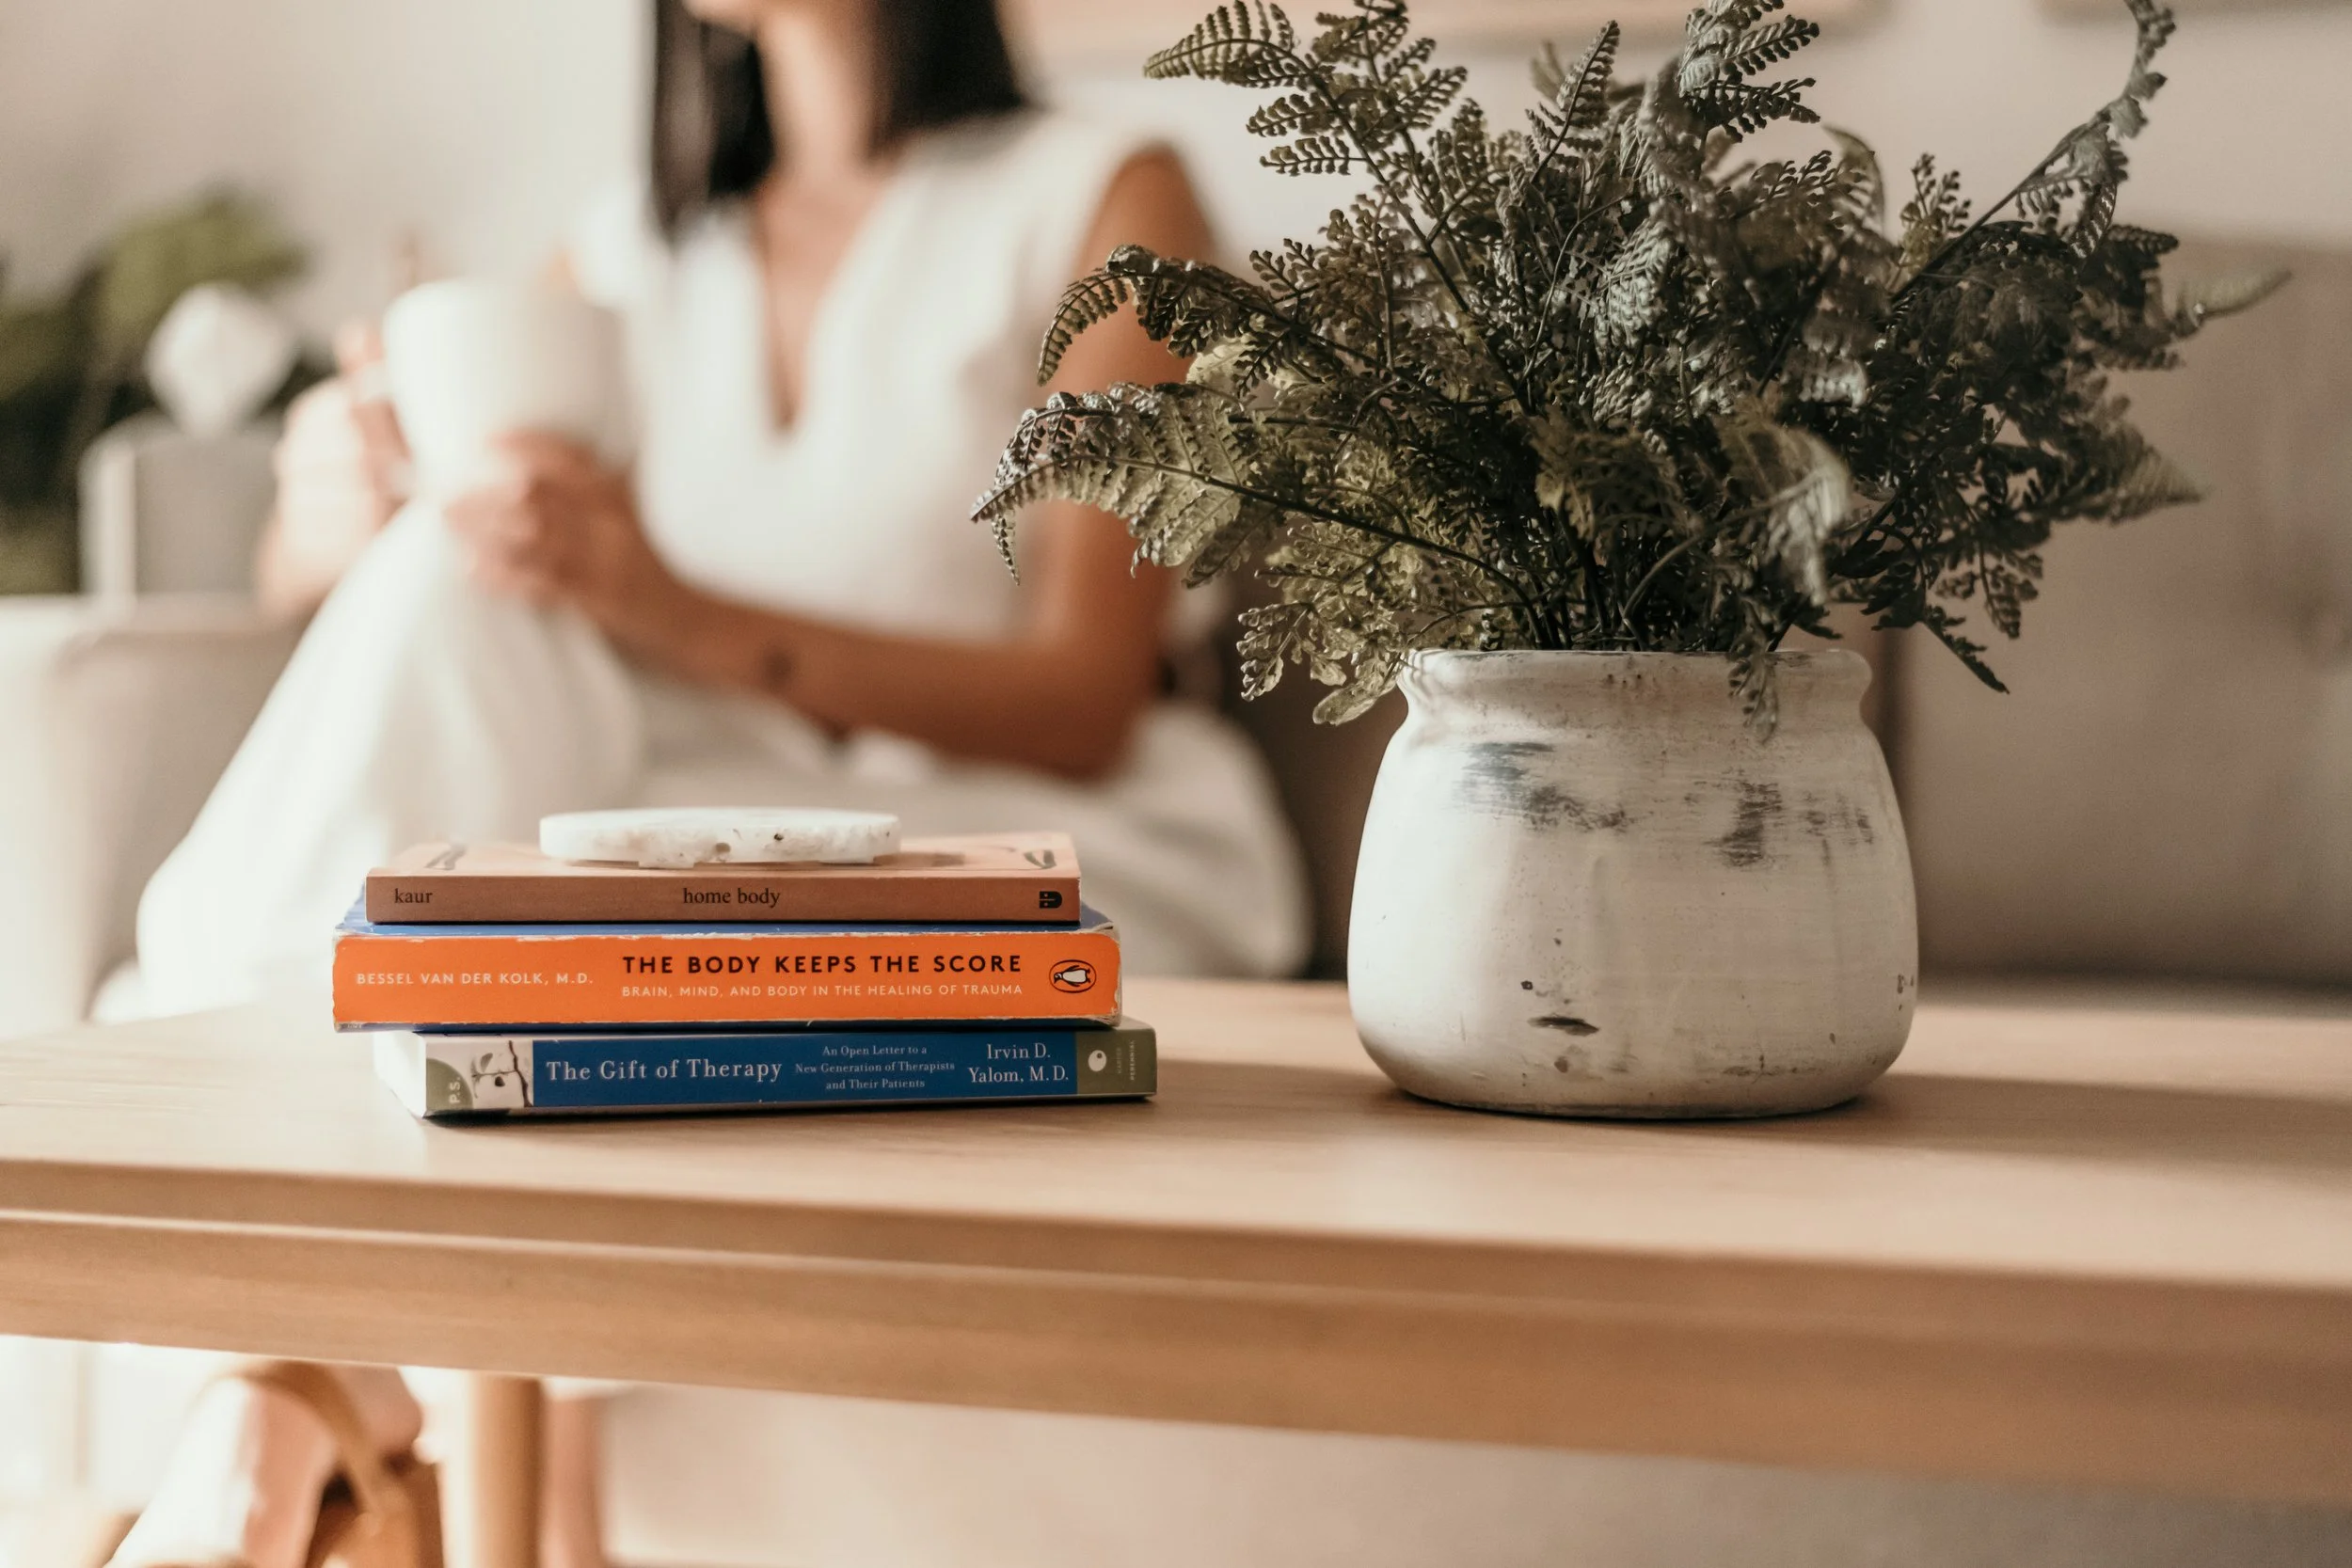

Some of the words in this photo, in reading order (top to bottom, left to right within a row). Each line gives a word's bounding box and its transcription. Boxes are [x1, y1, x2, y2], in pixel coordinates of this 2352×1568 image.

[393, 887, 434, 905] kaur
[683, 887, 732, 904] home
[737, 887, 781, 909] body
[622, 957, 674, 974] THE
[688, 957, 761, 974] BODY
[775, 956, 856, 973] KEEPS
[870, 956, 920, 973] THE
[933, 955, 1022, 972] SCORE
[357, 973, 414, 985] BESSEL
[420, 973, 454, 985] VAN
[461, 973, 493, 985] DER
[499, 973, 548, 986] KOLK,
[556, 973, 594, 985] M.D.
[622, 987, 673, 998] BRAIN,
[679, 987, 723, 998] MIND,
[730, 987, 761, 996] AND
[768, 986, 807, 996] BODY
[813, 986, 829, 996] IN
[834, 986, 861, 996] THE
[867, 985, 933, 996] HEALING
[939, 985, 957, 995] OF
[962, 985, 1023, 995] TRAUMA
[822, 1046, 838, 1056] An
[840, 1045, 869, 1058] Open
[872, 1045, 905, 1055] Letter
[908, 1045, 919, 1054] to
[987, 1044, 1030, 1060] Irvin
[1034, 1043, 1052, 1059] D.
[546, 1060, 591, 1081] The
[599, 1059, 647, 1080] Gift
[656, 1058, 679, 1079] of
[686, 1058, 783, 1082] Therapy
[795, 1063, 818, 1074] New
[820, 1062, 882, 1073] Generation
[884, 1061, 896, 1071] of
[898, 1060, 956, 1074] Therapists
[967, 1067, 1025, 1083] Yalom,
[825, 1081, 847, 1090] and
[849, 1079, 879, 1090] Their
[882, 1078, 926, 1089] Patients
